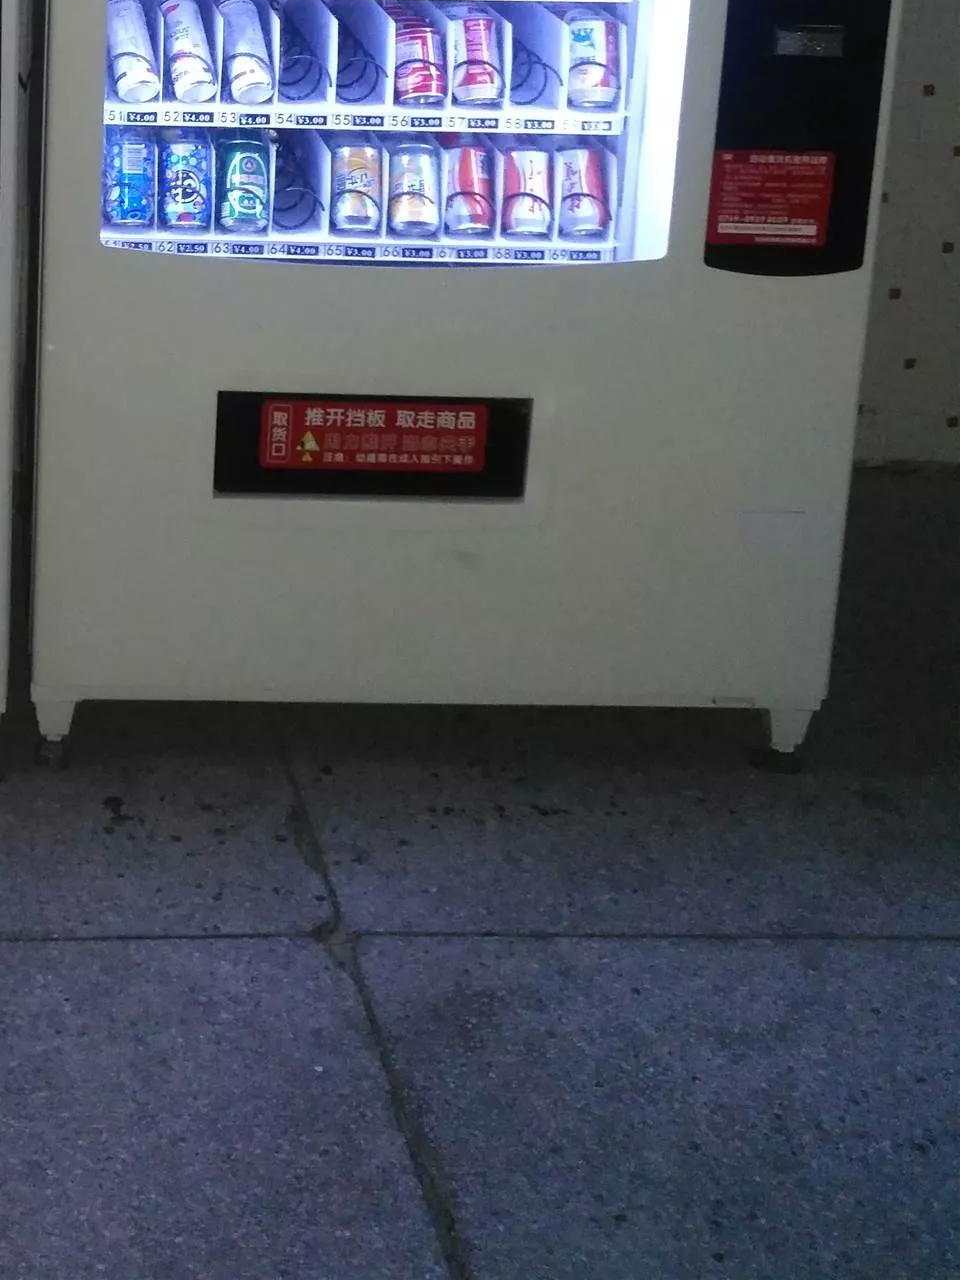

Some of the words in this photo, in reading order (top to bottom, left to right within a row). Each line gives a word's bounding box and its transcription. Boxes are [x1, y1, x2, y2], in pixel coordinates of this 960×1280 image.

[164, 112, 179, 121] 52
[184, 113, 211, 122] ¥4.00
[221, 113, 235, 123] 53
[277, 114, 292, 124] 54
[297, 116, 325, 125] ¥3.00
[335, 114, 350, 125] 55
[354, 117, 382, 125] ¥3.00
[392, 116, 407, 127] 56
[158, 242, 173, 252] 62
[215, 242, 230, 253] 63
[271, 243, 286, 254] 64
[288, 246, 317, 255] ¥4.00
[327, 244, 341, 255] 65
[383, 248, 399, 257] 66
[496, 249, 511, 259] 68
[552, 250, 567, 260] 69
[304, 408, 386, 428] 推开挡板
[395, 409, 476, 430] 取走商品
